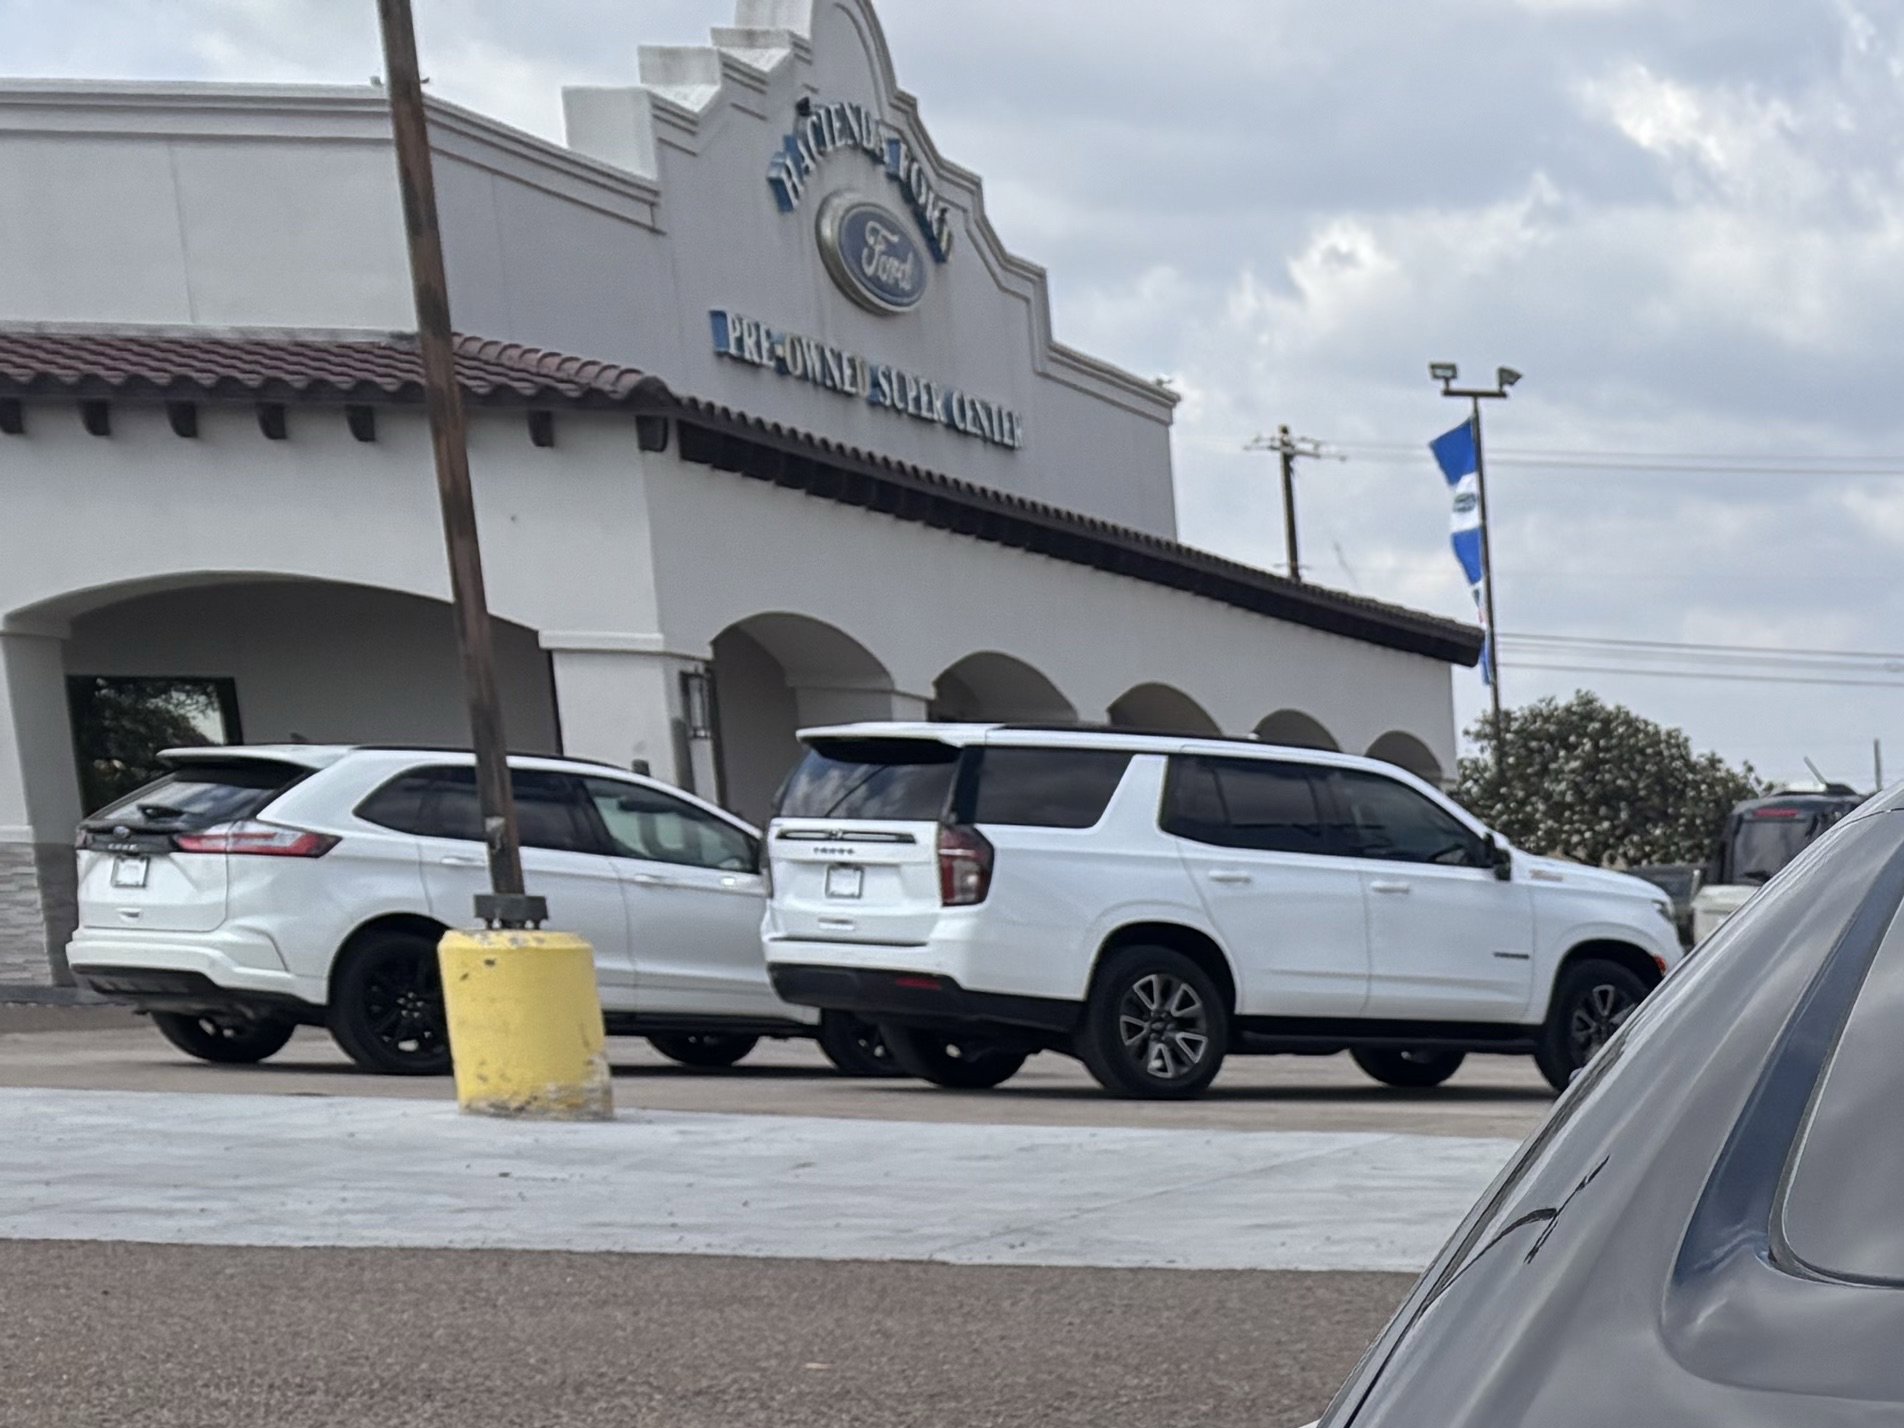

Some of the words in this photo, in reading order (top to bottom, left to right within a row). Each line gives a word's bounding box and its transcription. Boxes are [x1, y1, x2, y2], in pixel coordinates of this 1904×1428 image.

[861, 220, 913, 291] Ford
[713, 310, 870, 399] PRE-OWNED
[876, 364, 949, 425] SUPER
[949, 389, 1024, 450] CENTER
